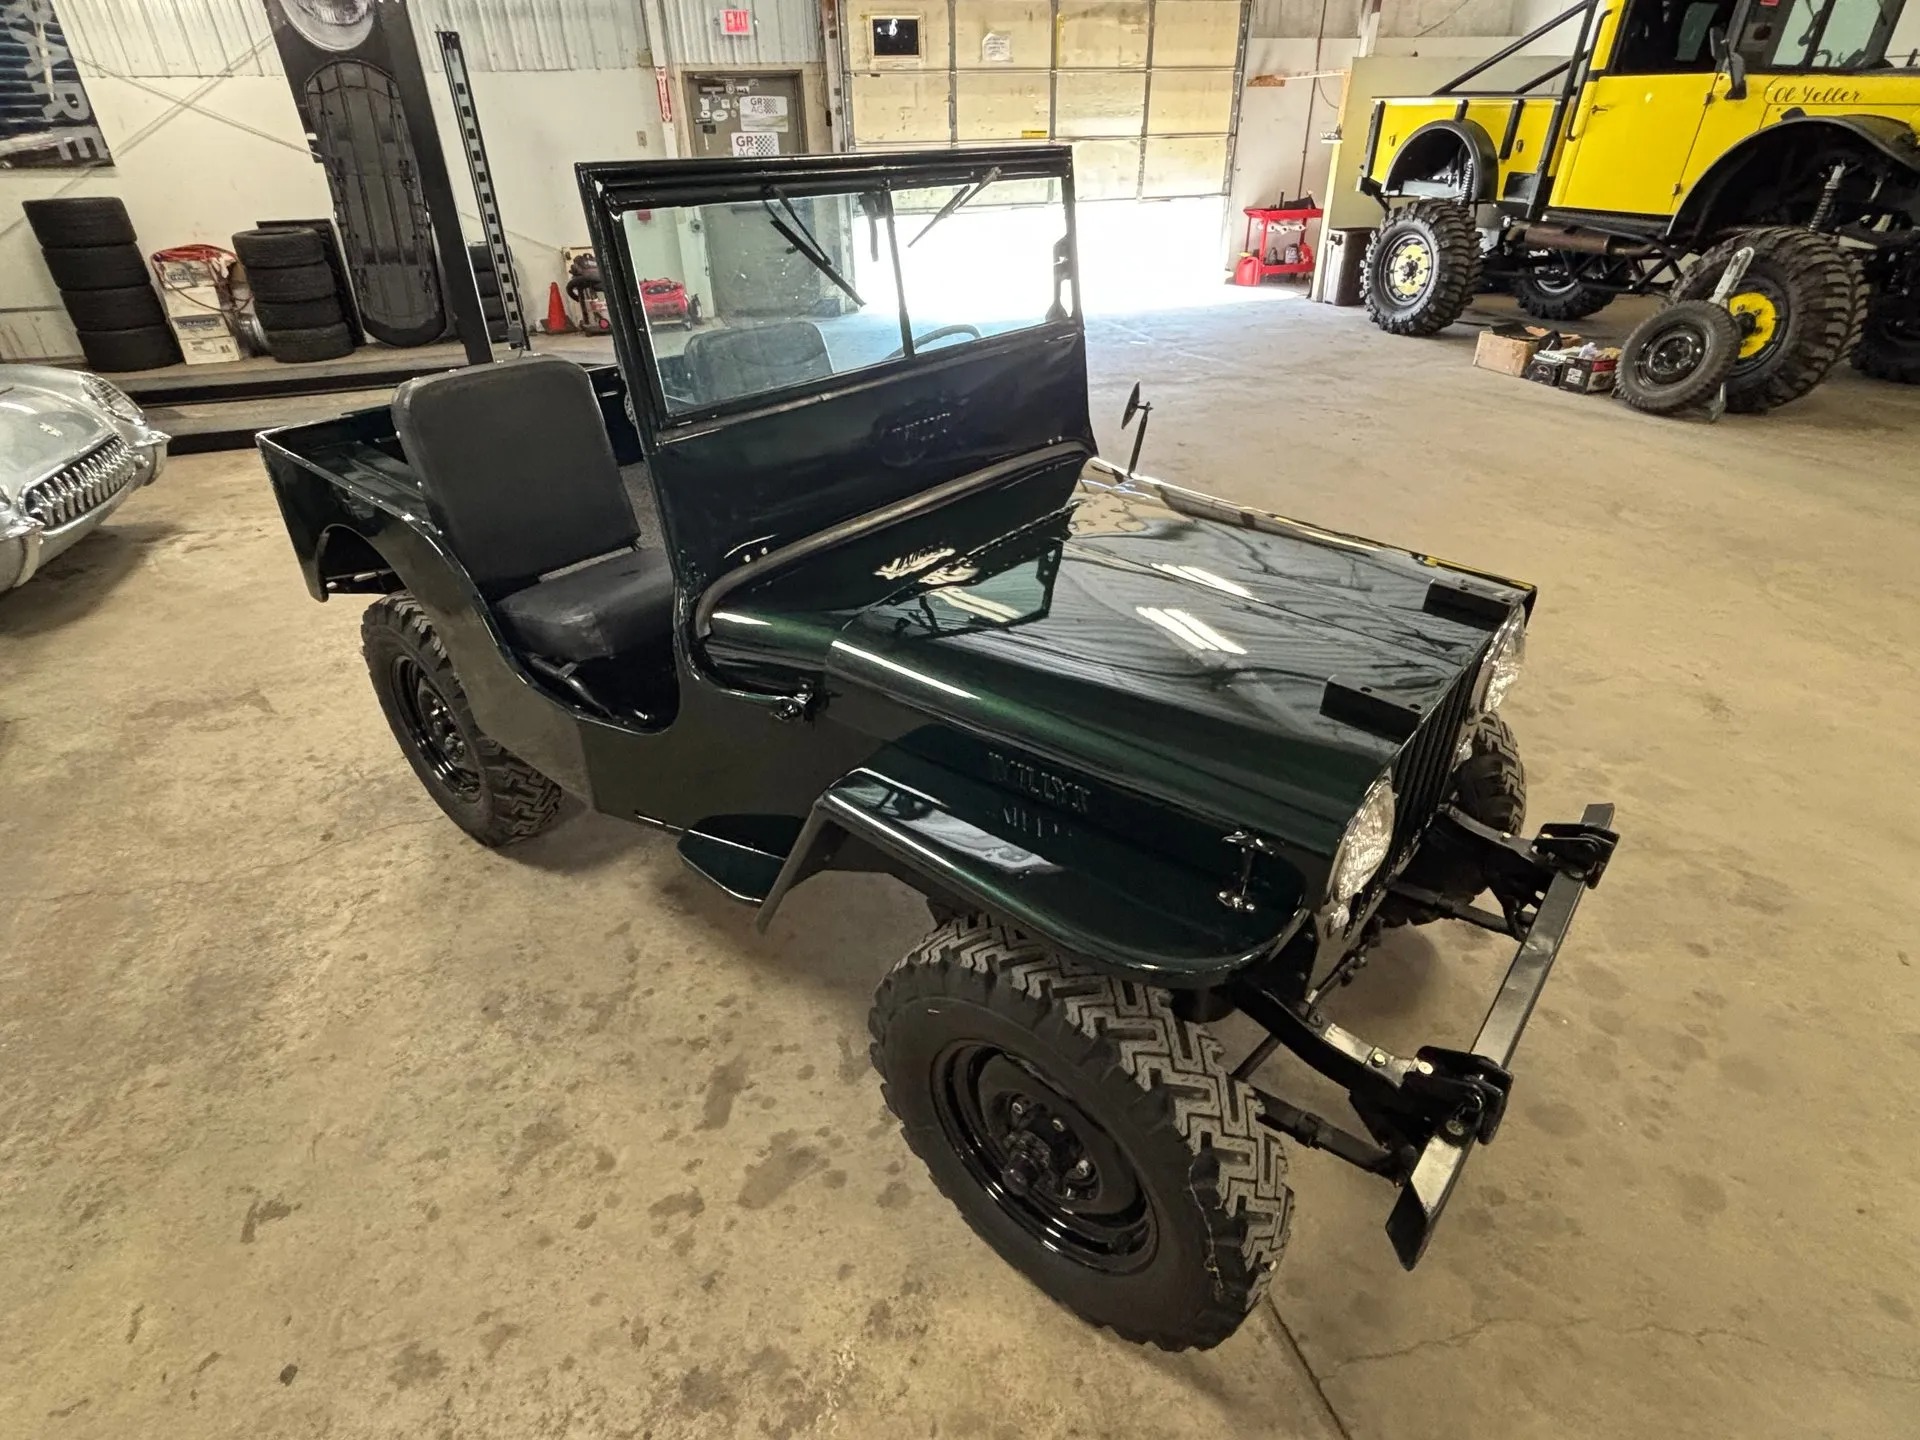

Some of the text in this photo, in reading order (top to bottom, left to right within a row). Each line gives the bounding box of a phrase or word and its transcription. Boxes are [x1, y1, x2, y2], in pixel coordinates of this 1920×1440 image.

[725, 11, 748, 31] EXIT
[1773, 86, 1861, 103] Ol Yeller
[750, 97, 763, 106] GR
[736, 135, 755, 147] GR
[738, 147, 756, 156] AG
